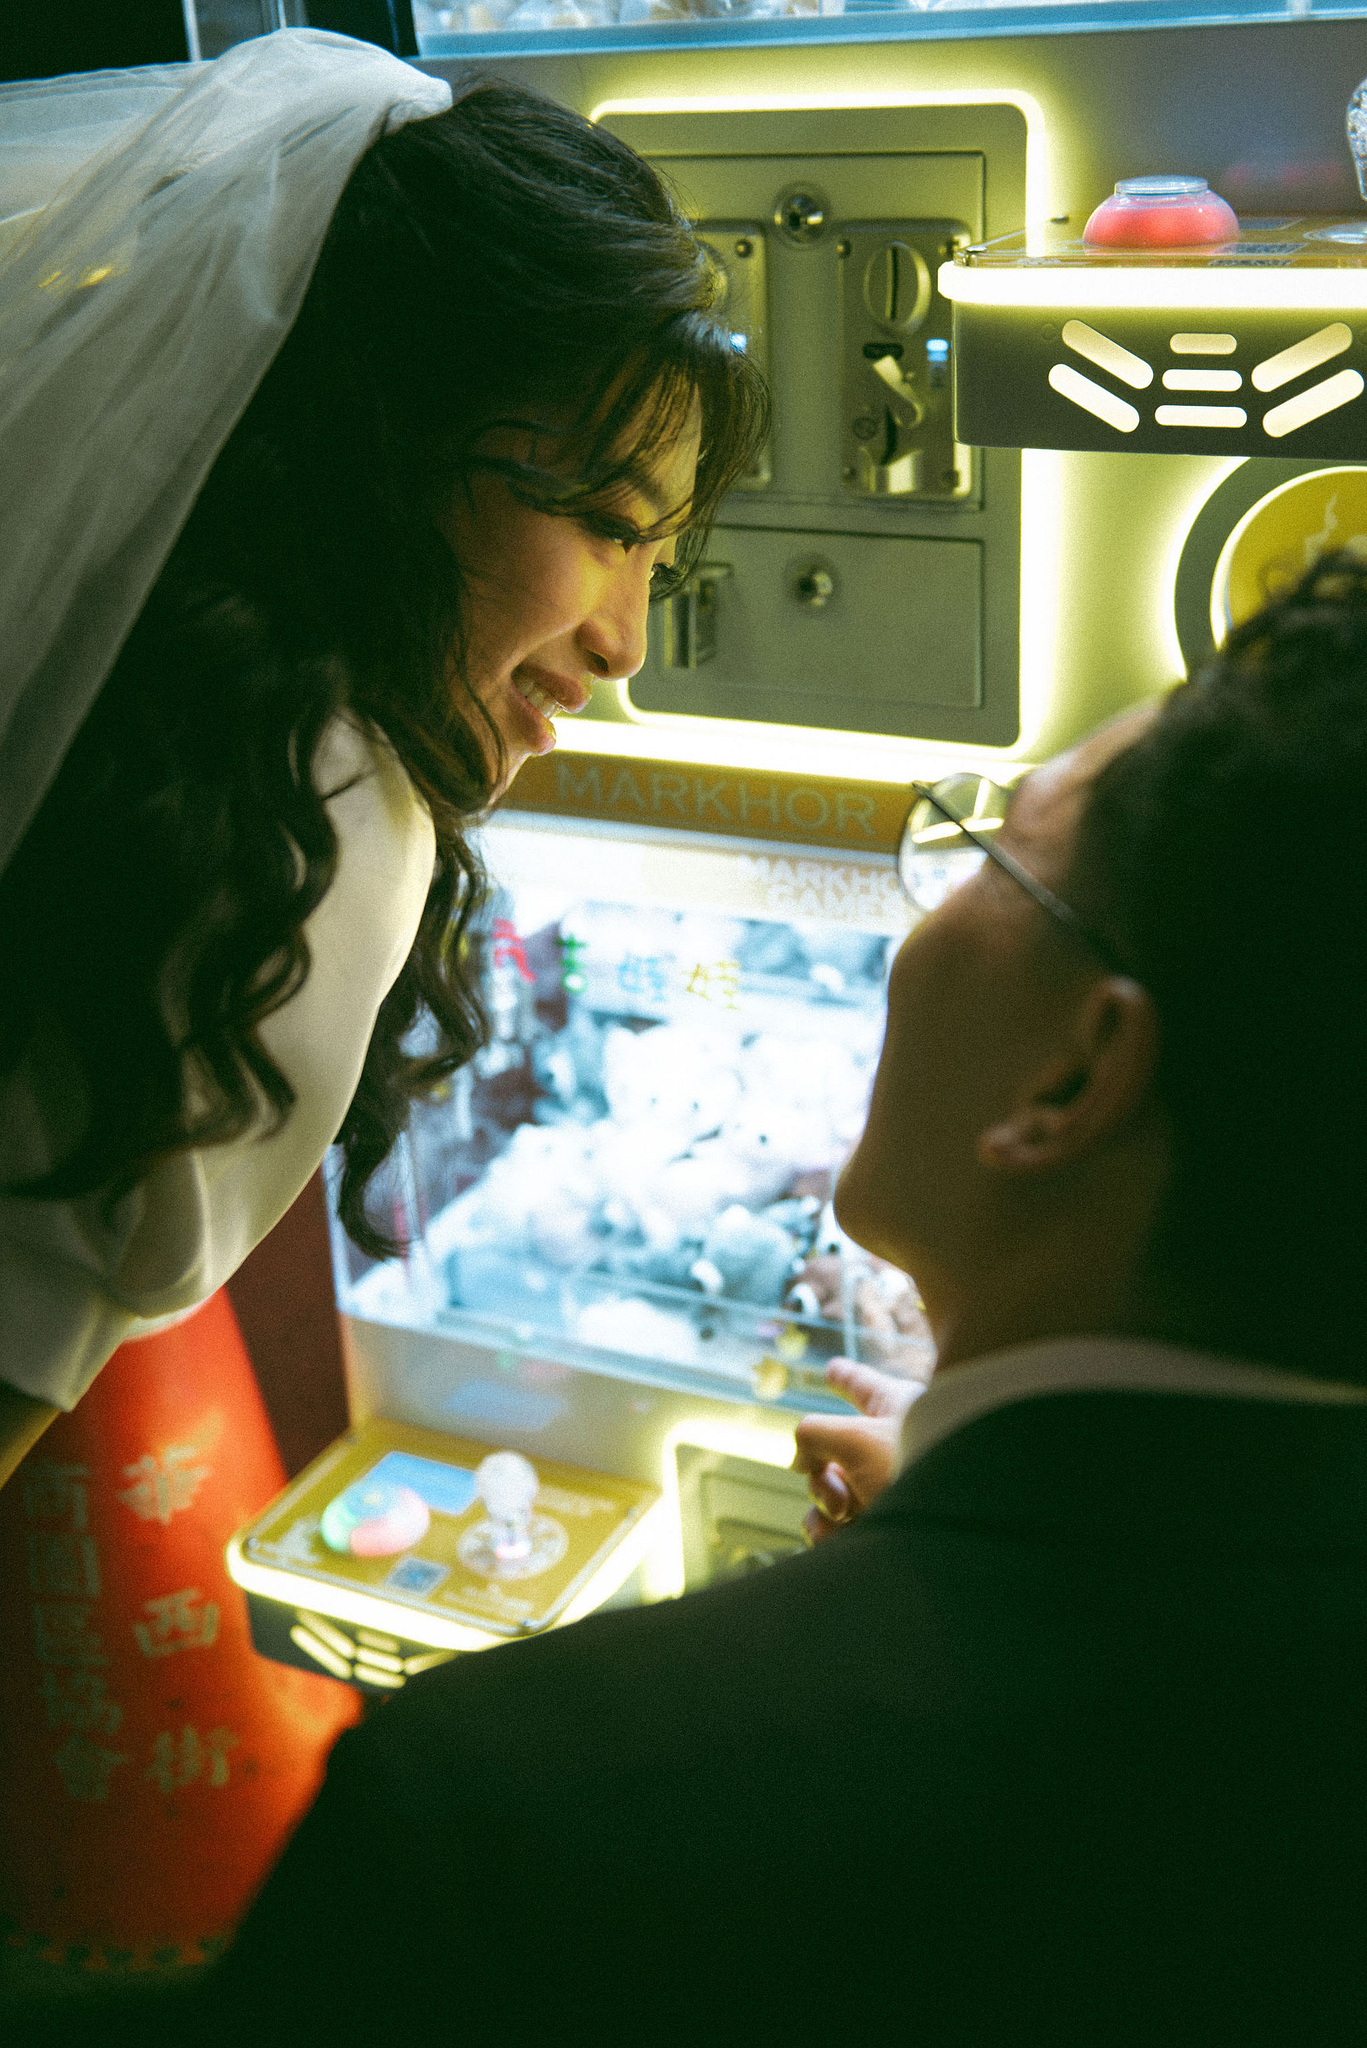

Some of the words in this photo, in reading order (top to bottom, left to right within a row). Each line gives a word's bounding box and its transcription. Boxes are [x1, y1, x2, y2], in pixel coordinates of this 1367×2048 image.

[554, 761, 880, 838] MARKHOR
[737, 854, 901, 899] MARKHO
[766, 883, 907, 926] GAMES
